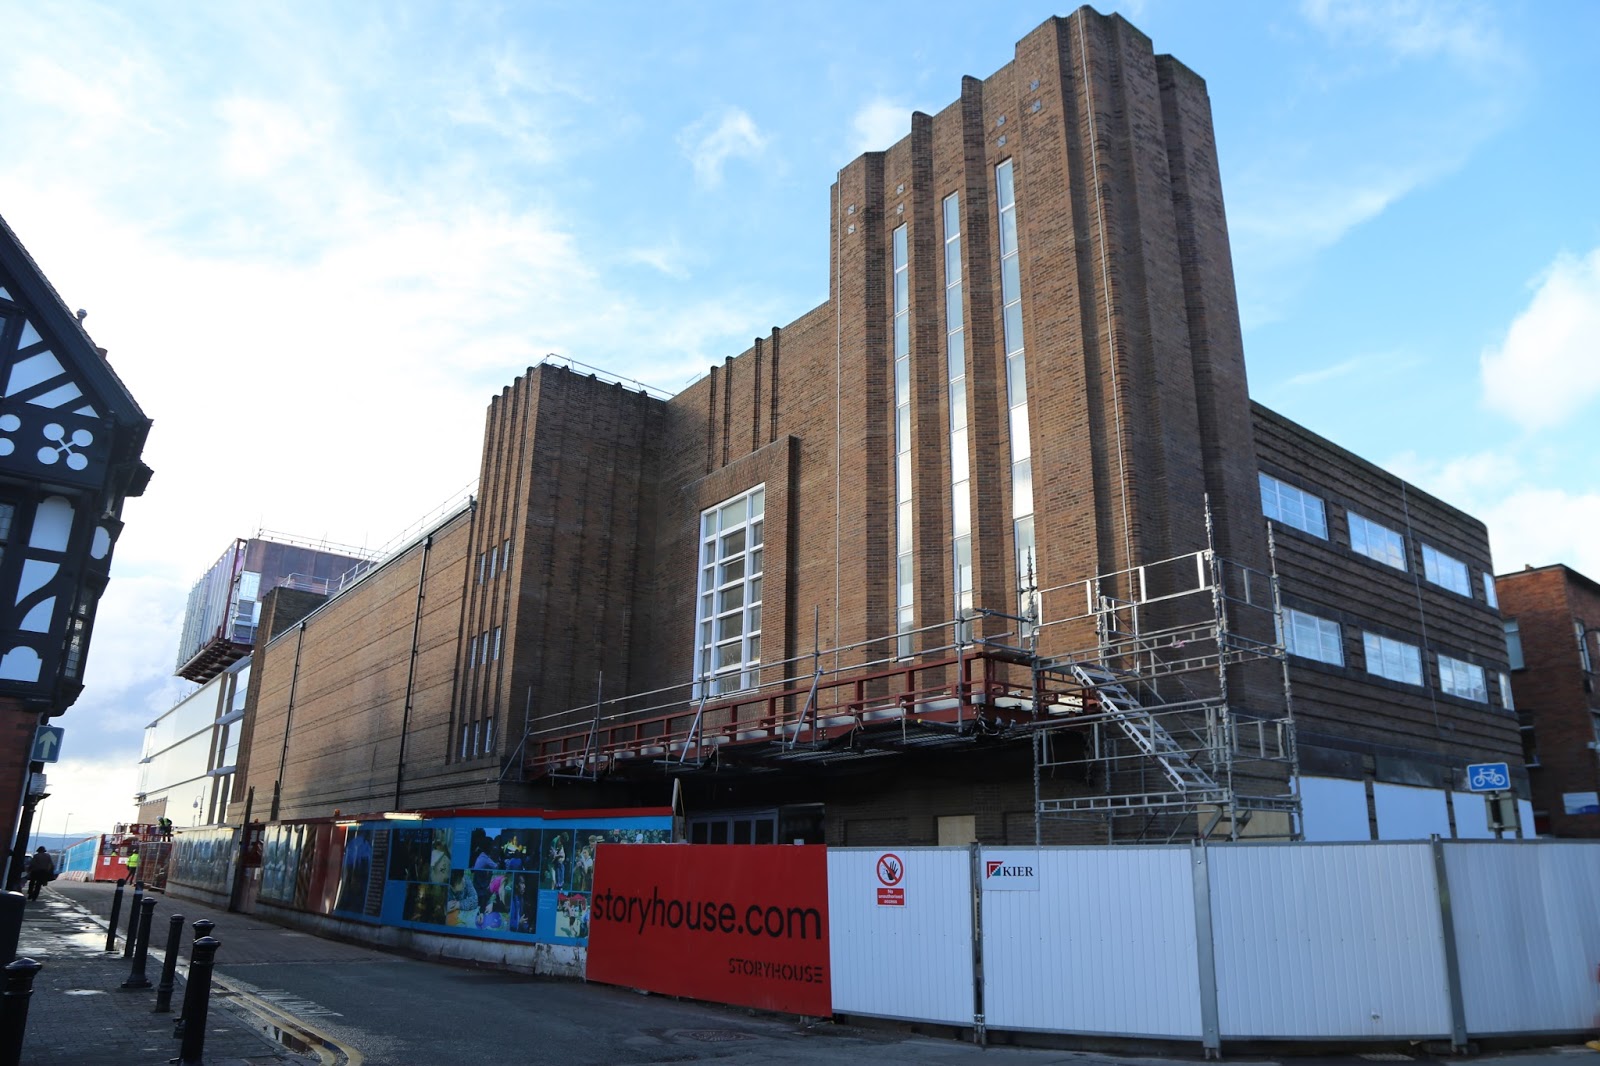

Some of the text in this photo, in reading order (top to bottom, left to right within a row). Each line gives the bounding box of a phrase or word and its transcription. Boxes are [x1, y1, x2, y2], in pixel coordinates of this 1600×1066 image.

[1002, 866, 1034, 877] KIER
[593, 886, 822, 940] storyhouse.com
[728, 957, 823, 984] STORYHOUSE
